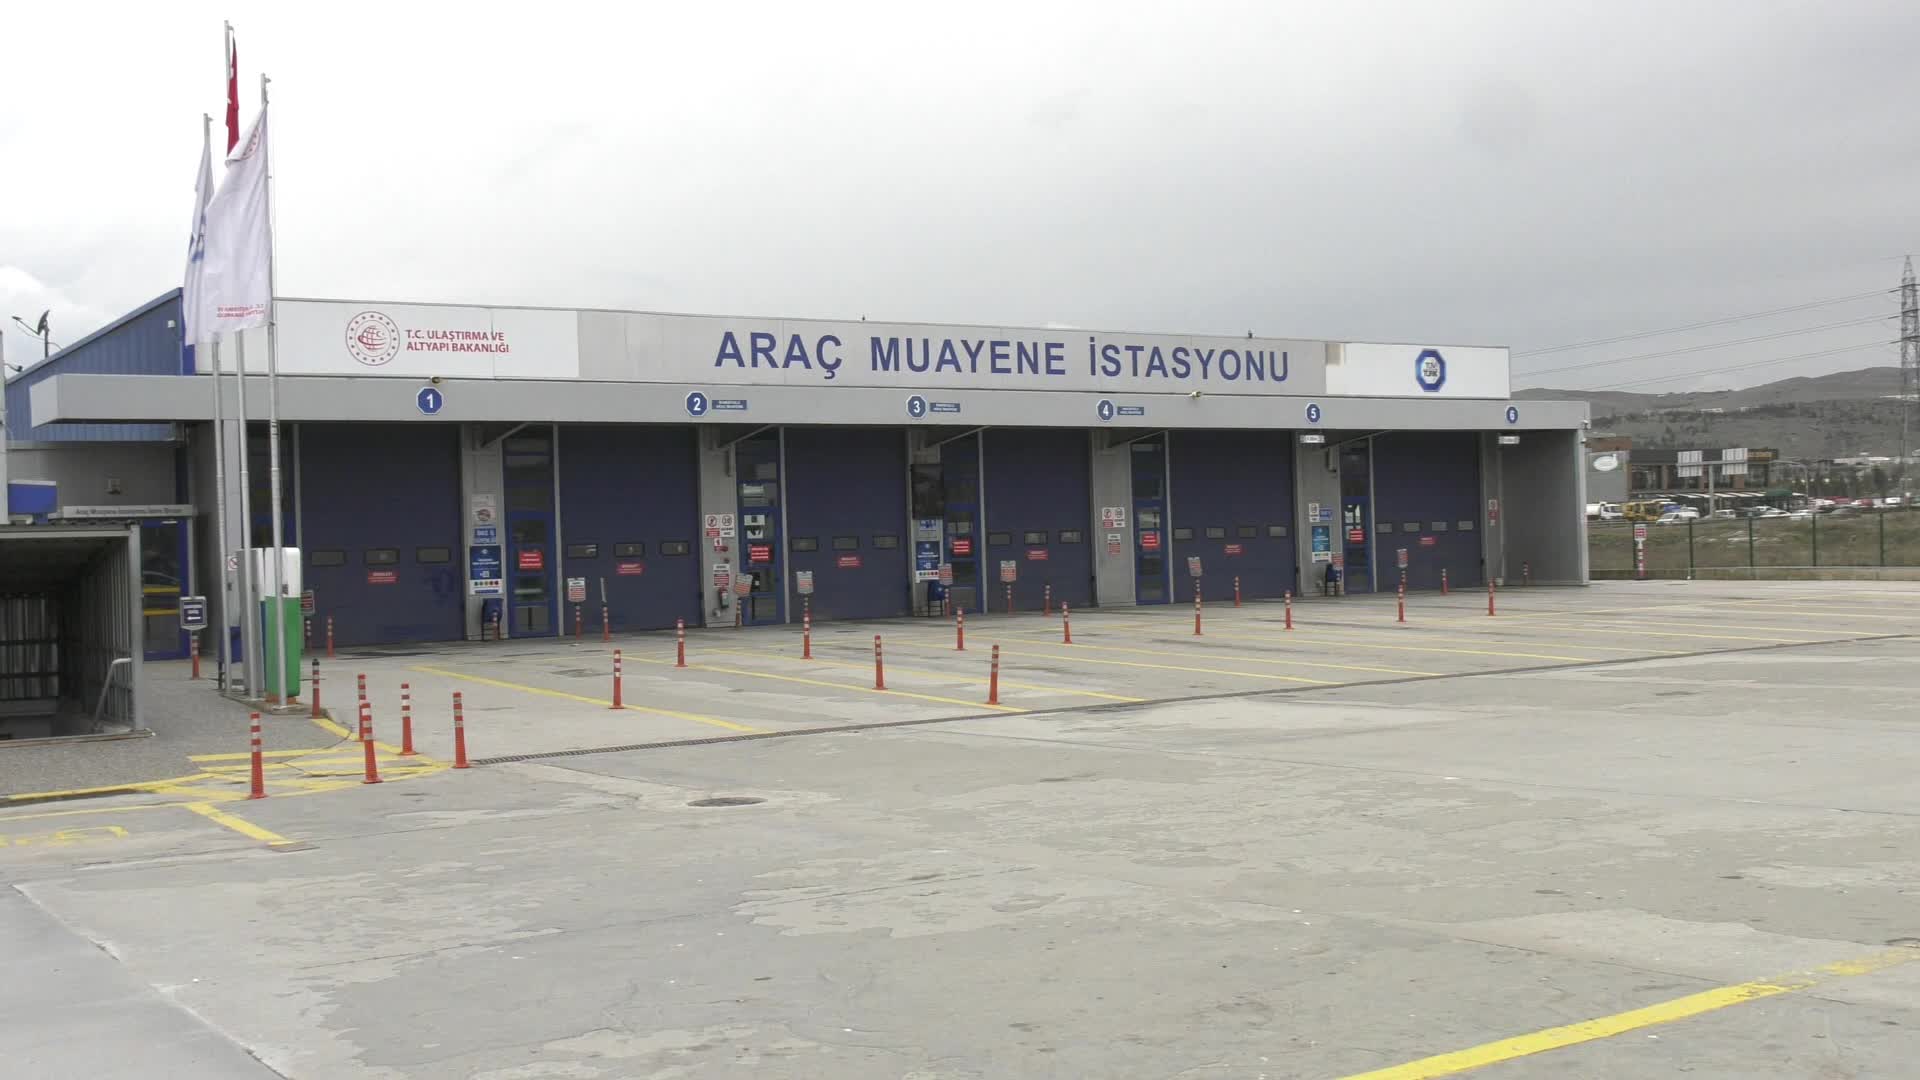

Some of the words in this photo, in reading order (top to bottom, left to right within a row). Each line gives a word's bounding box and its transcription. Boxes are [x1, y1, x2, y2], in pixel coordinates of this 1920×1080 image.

[406, 330, 424, 339] T.C.
[428, 331, 488, 342] ULAŞTIRMA
[491, 332, 504, 341] VE
[407, 342, 449, 352] ALTYAPI
[452, 342, 509, 353] BAKANLIĞI
[714, 331, 843, 379] ARAÇ
[870, 336, 1066, 376] MUAYENE
[1089, 336, 1289, 382] İSTASYONU
[427, 394, 433, 408] 1
[693, 398, 701, 411] 2
[913, 401, 920, 413] 3
[1102, 404, 1109, 416] 4
[1310, 407, 1317, 419] 5
[1509, 410, 1515, 421] 6
